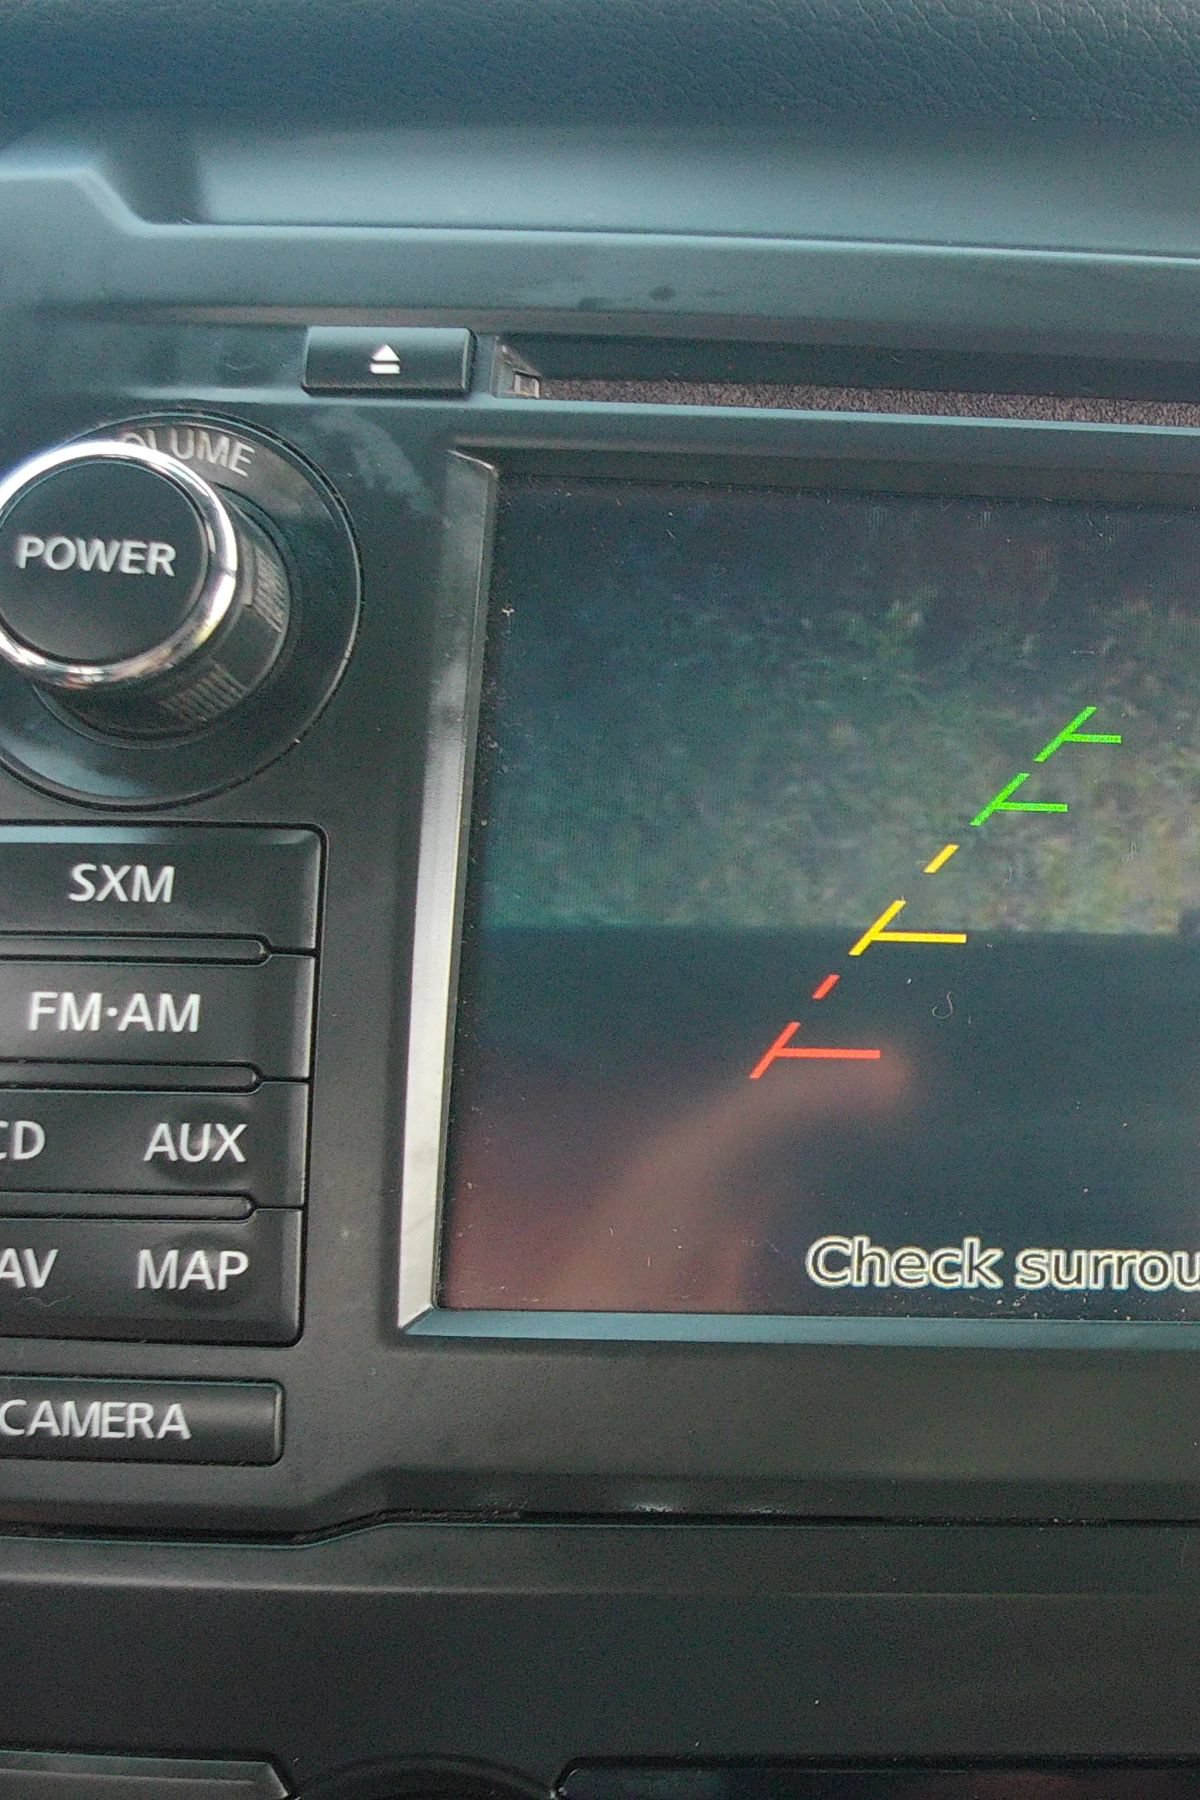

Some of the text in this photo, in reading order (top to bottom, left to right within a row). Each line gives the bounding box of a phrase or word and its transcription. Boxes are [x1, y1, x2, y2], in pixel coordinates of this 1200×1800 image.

[15, 534, 177, 577] POWER
[67, 863, 176, 903] SXM
[143, 1122, 248, 1163] AUX
[135, 1249, 249, 1291] MAP
[805, 1235, 1004, 1289] Check
[0, 1398, 193, 1441] CAMERA
